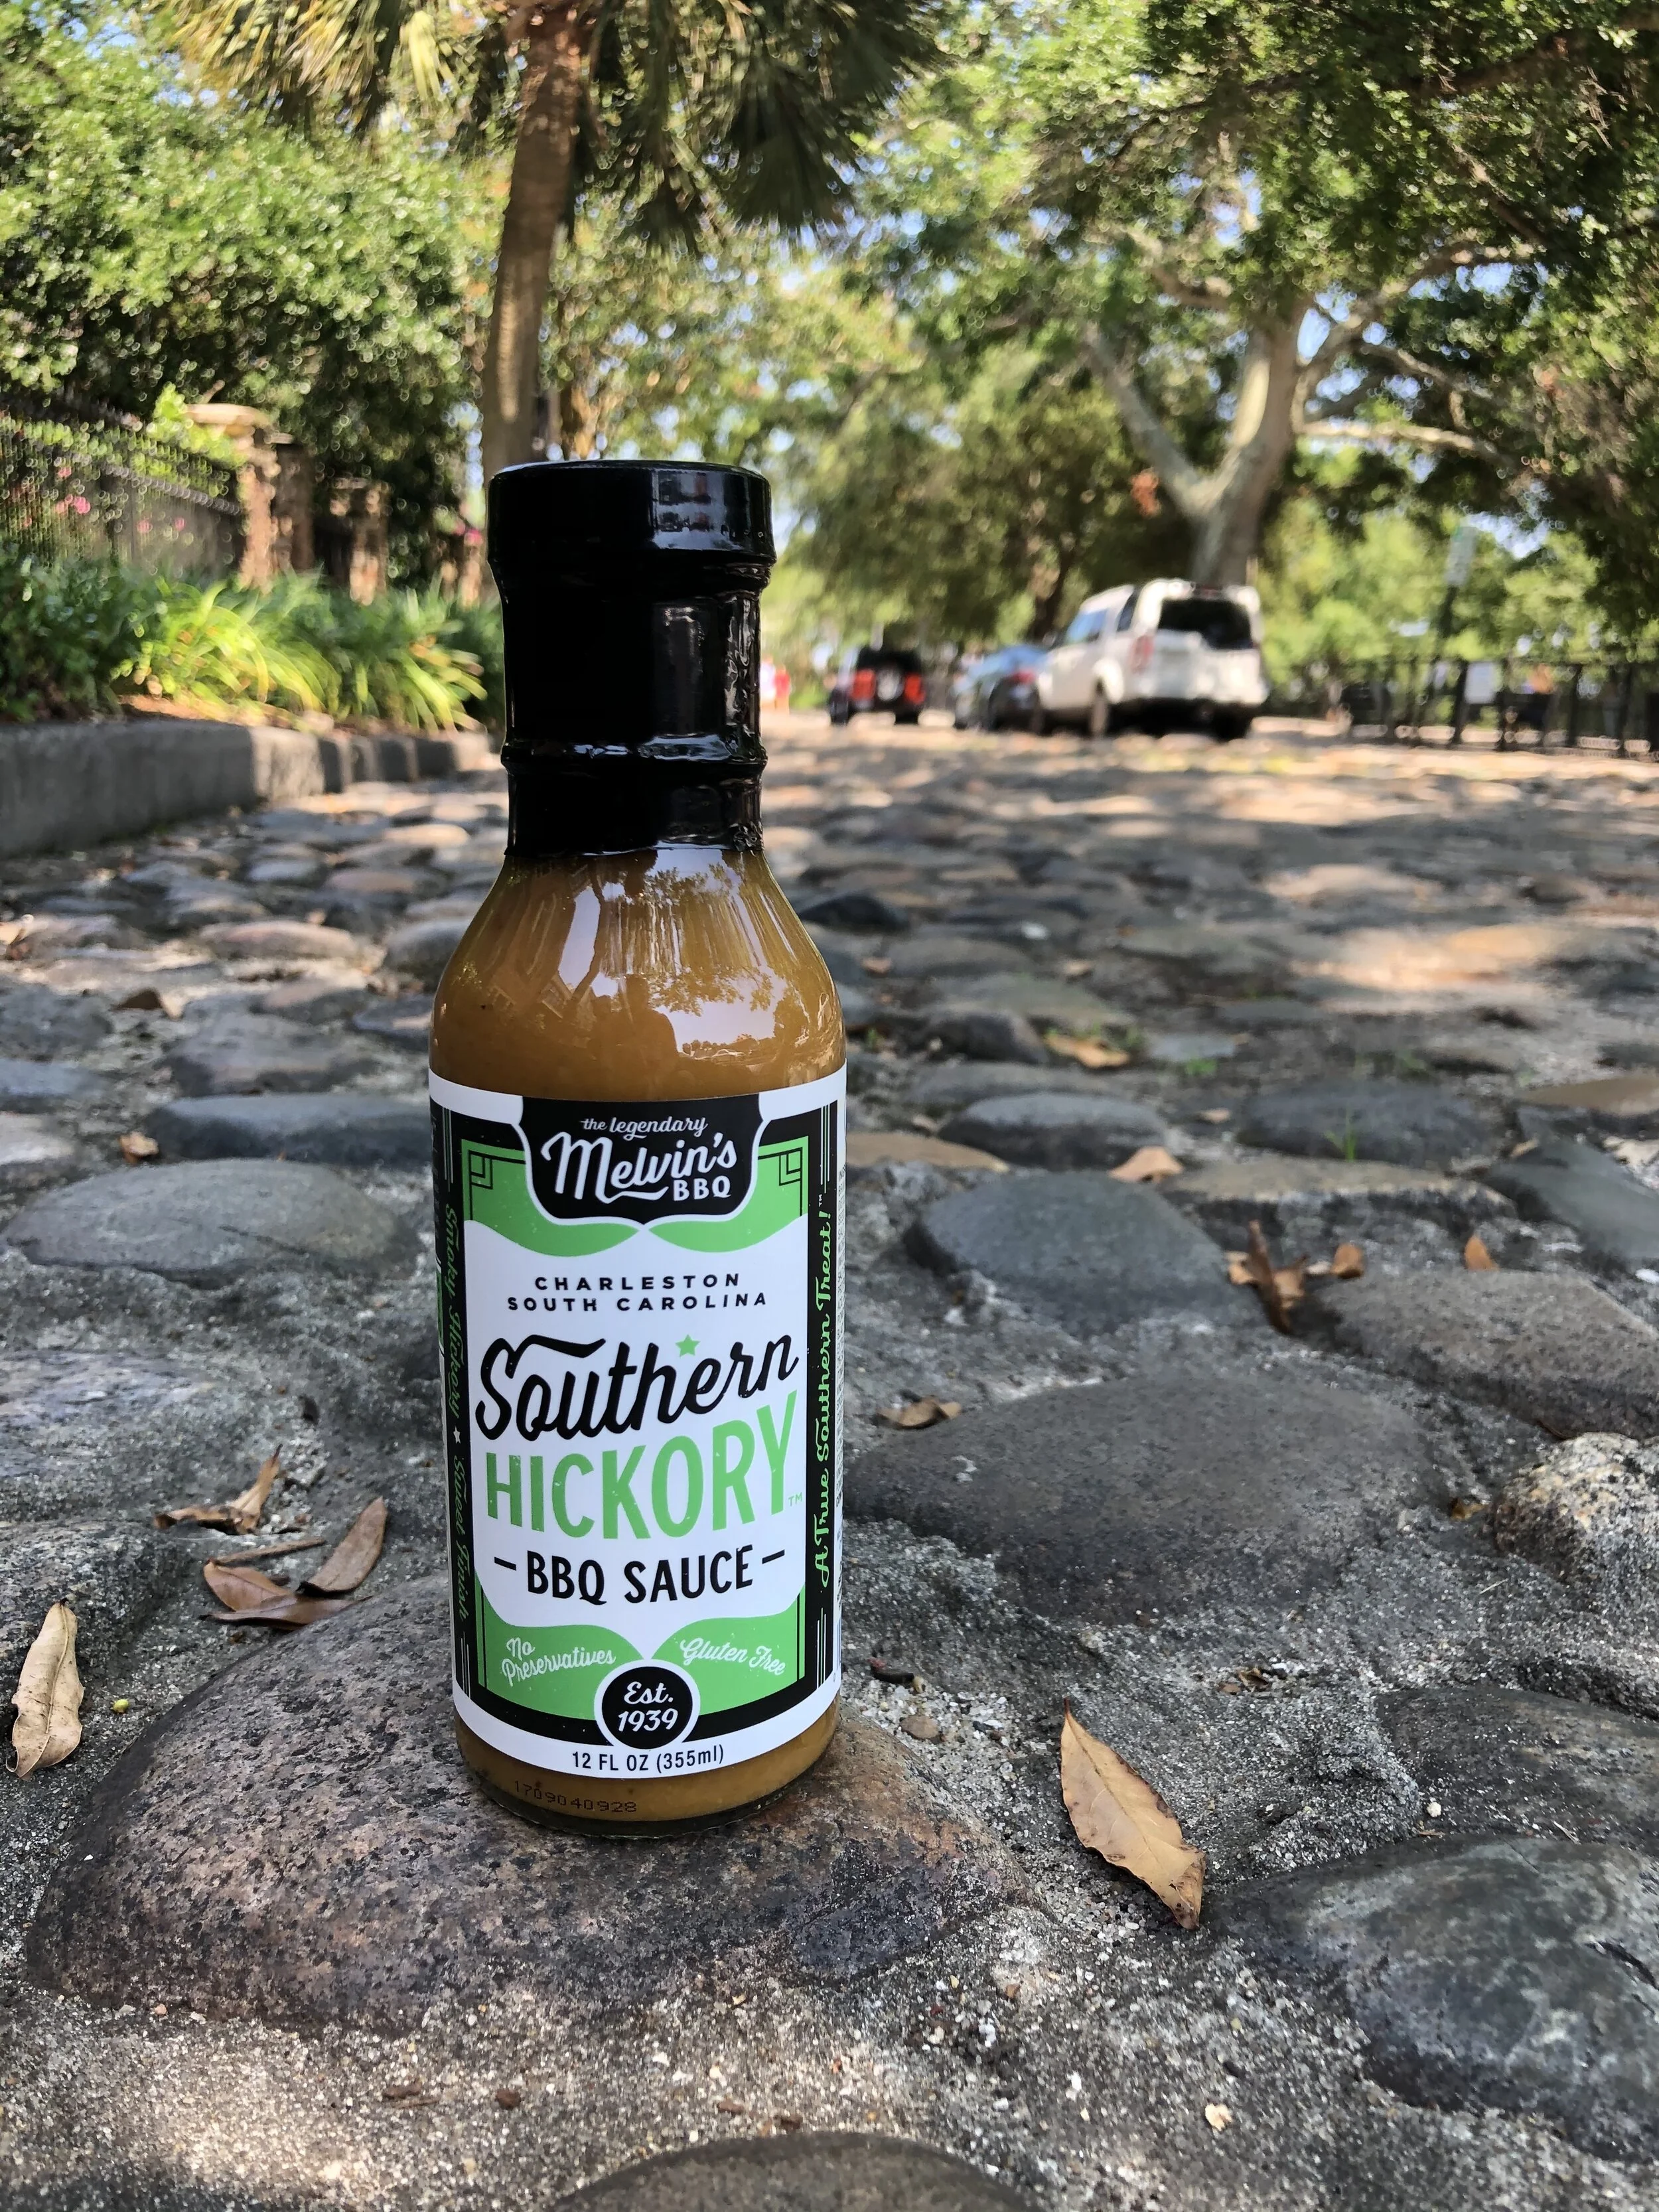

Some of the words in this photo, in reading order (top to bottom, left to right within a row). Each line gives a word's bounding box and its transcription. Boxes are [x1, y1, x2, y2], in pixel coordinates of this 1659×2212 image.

[580, 1117, 607, 1130] the
[608, 1115, 708, 1140] legendary
[540, 1131, 737, 1204] Melvin's
[673, 1178, 731, 1201] BBQ
[445, 1203, 460, 1297] Smoky
[816, 1211, 831, 1311] Treat!
[508, 1297, 597, 1311] SOUTH
[617, 1292, 766, 1311] CAROLINA
[535, 1273, 739, 1291] CHARLESTON
[449, 1305, 465, 1419] Hickory
[475, 1334, 799, 1441] Southern
[816, 1314, 831, 1462] Southern
[486, 1390, 797, 1539] HICKORY
[453, 1455, 467, 1534] Sweet
[814, 1468, 830, 1546] True
[456, 1540, 470, 1621] Finish
[526, 1550, 607, 1606] BBQ
[624, 1544, 753, 1603] SAUCE
[814, 1546, 830, 1587] A
[502, 1646, 616, 1686] Preservatives
[506, 1637, 536, 1657] No
[680, 1637, 747, 1665] Gluten
[750, 1645, 786, 1676] Free
[623, 1681, 674, 1705] Est.
[617, 1709, 678, 1732] 1939
[571, 1751, 591, 1769] 12
[599, 1752, 618, 1771] FL
[626, 1751, 649, 1771] OZ
[656, 1743, 725, 1773] (355ml)
